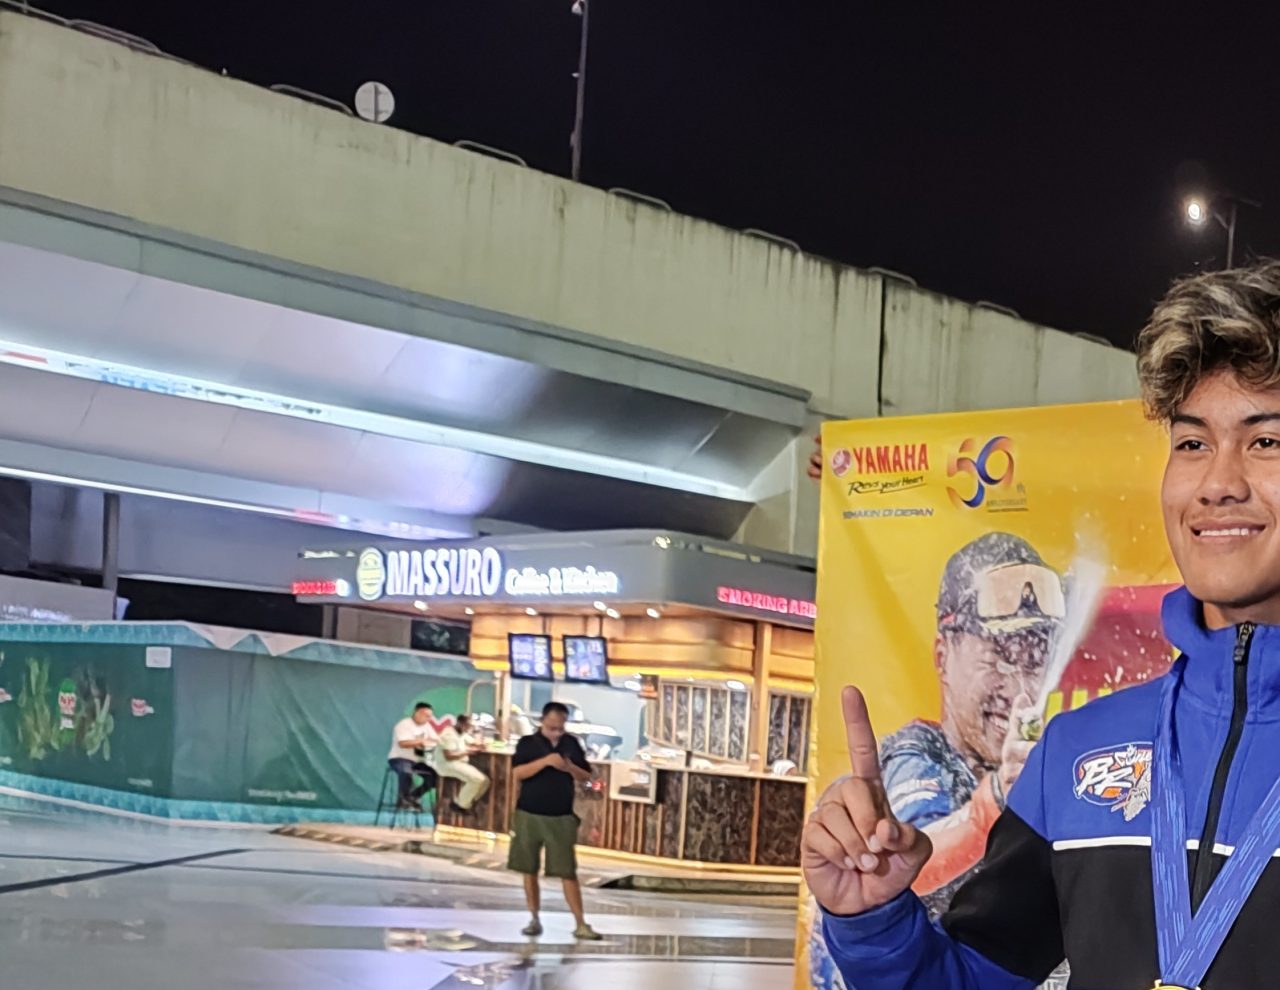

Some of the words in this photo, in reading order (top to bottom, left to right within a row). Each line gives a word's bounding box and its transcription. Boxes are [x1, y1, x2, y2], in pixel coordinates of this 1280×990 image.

[853, 443, 929, 474] YAMAHA
[386, 547, 502, 597] MASSURO
[717, 586, 788, 614] SMOKING
